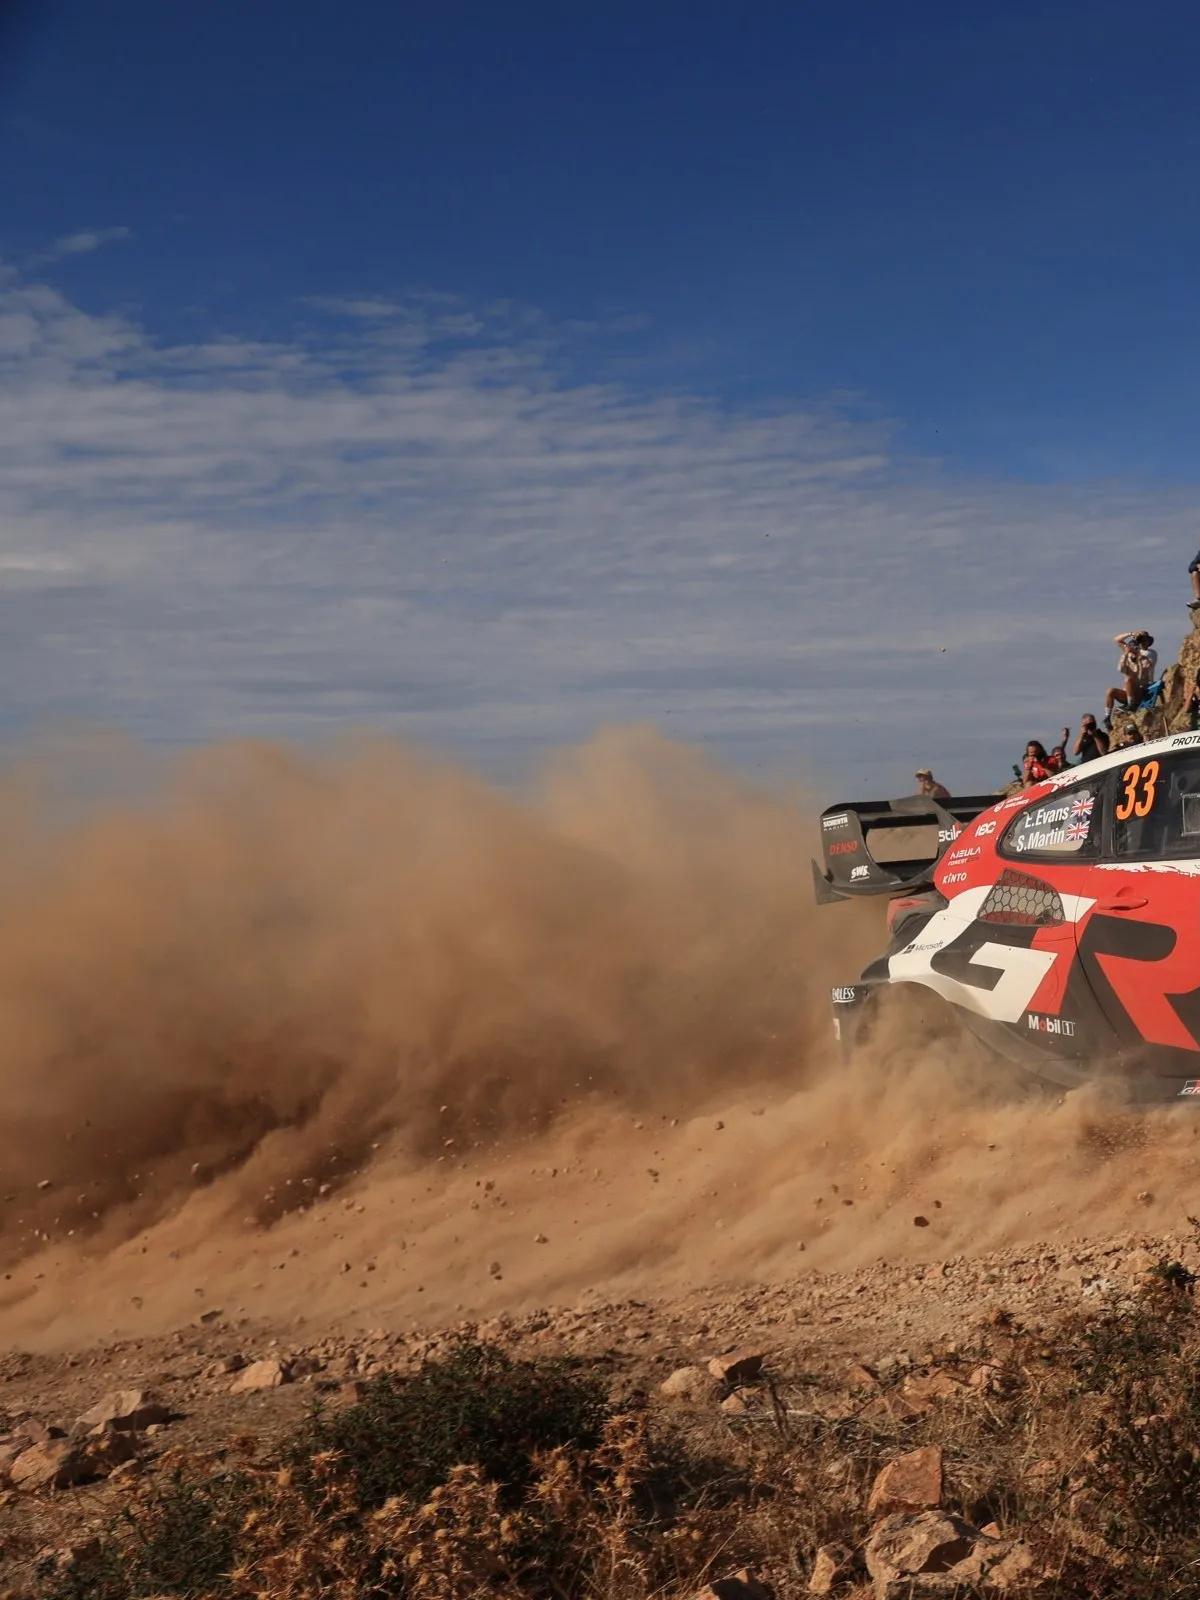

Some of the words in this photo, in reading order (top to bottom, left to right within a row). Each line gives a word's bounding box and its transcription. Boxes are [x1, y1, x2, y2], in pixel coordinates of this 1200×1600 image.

[1116, 760, 1160, 820] 33
[1024, 806, 1070, 829] E.Evans
[1016, 827, 1065, 853] S.Martin
[1028, 1014, 1061, 1035] Mobil
